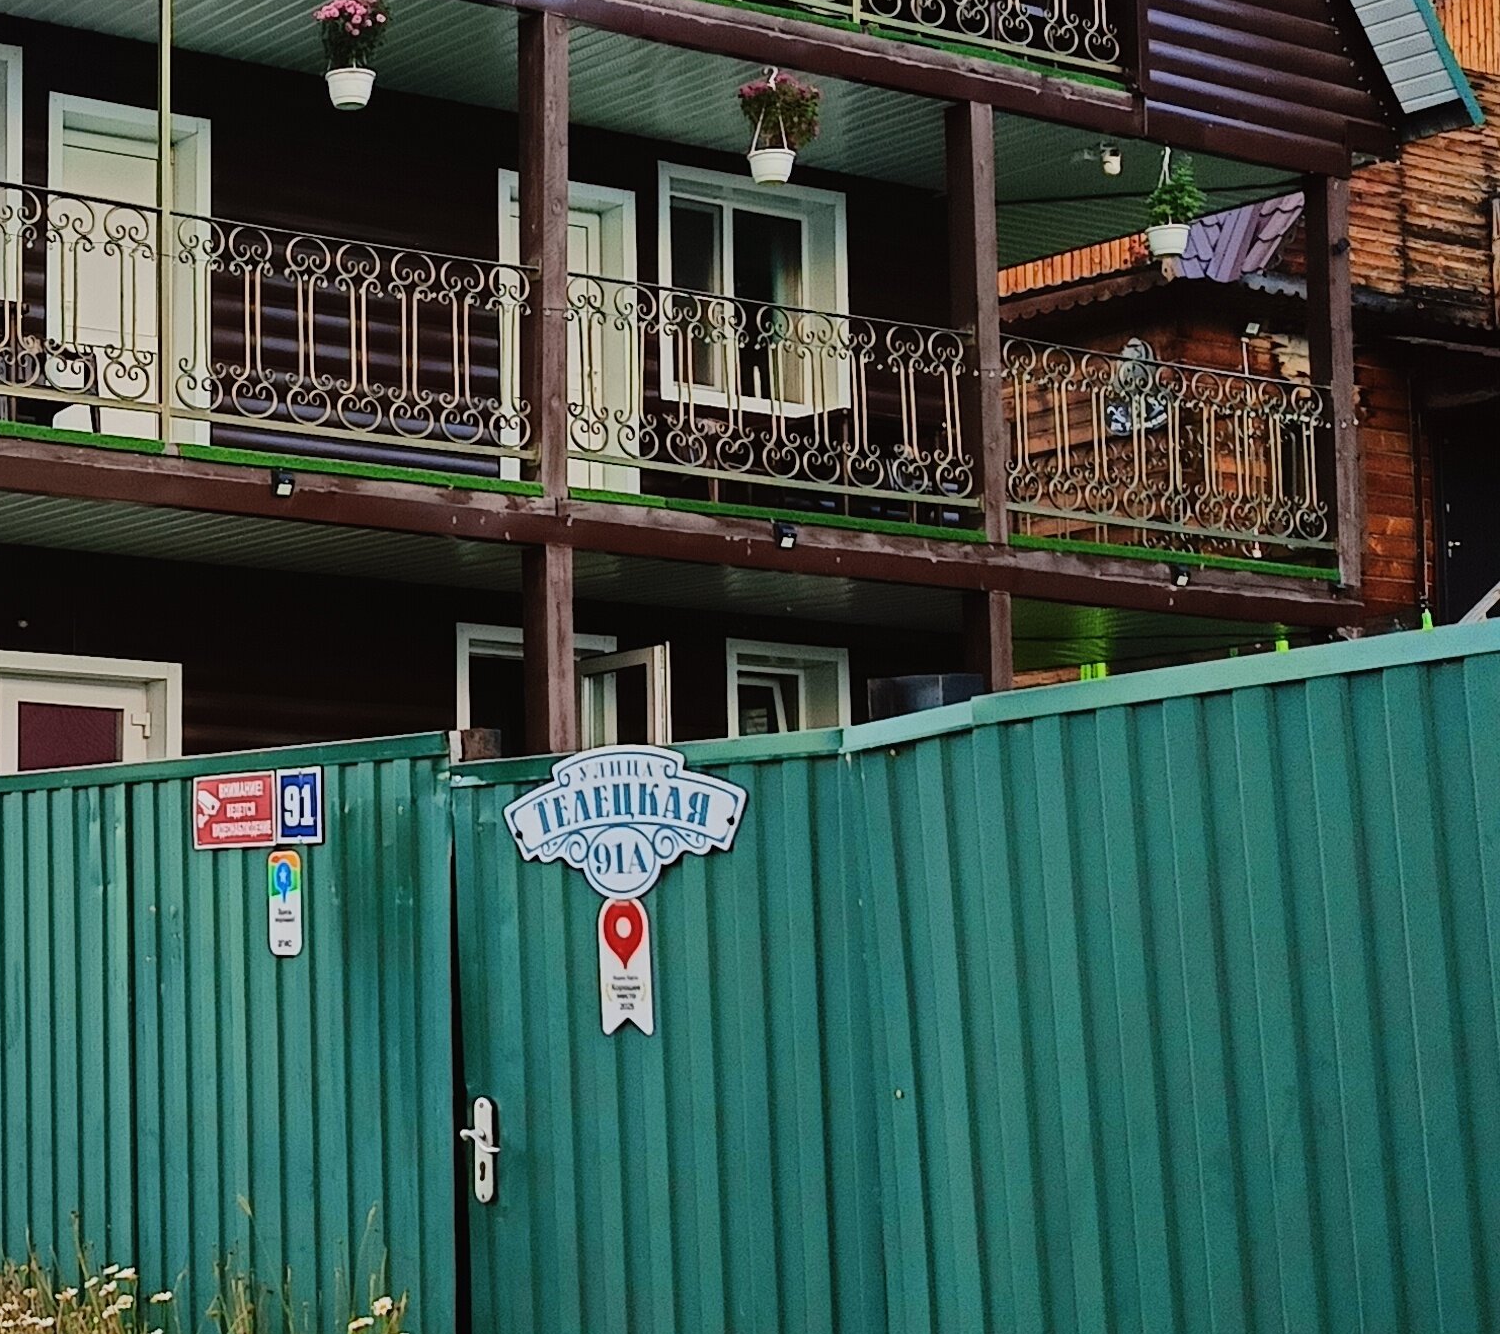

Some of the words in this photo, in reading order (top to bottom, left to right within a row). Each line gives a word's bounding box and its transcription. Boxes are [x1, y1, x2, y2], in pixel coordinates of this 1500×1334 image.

[580, 759, 653, 782] УЛИЦА
[283, 784, 315, 827] 91
[533, 782, 711, 835] ТЕЛЕЦКАЯ
